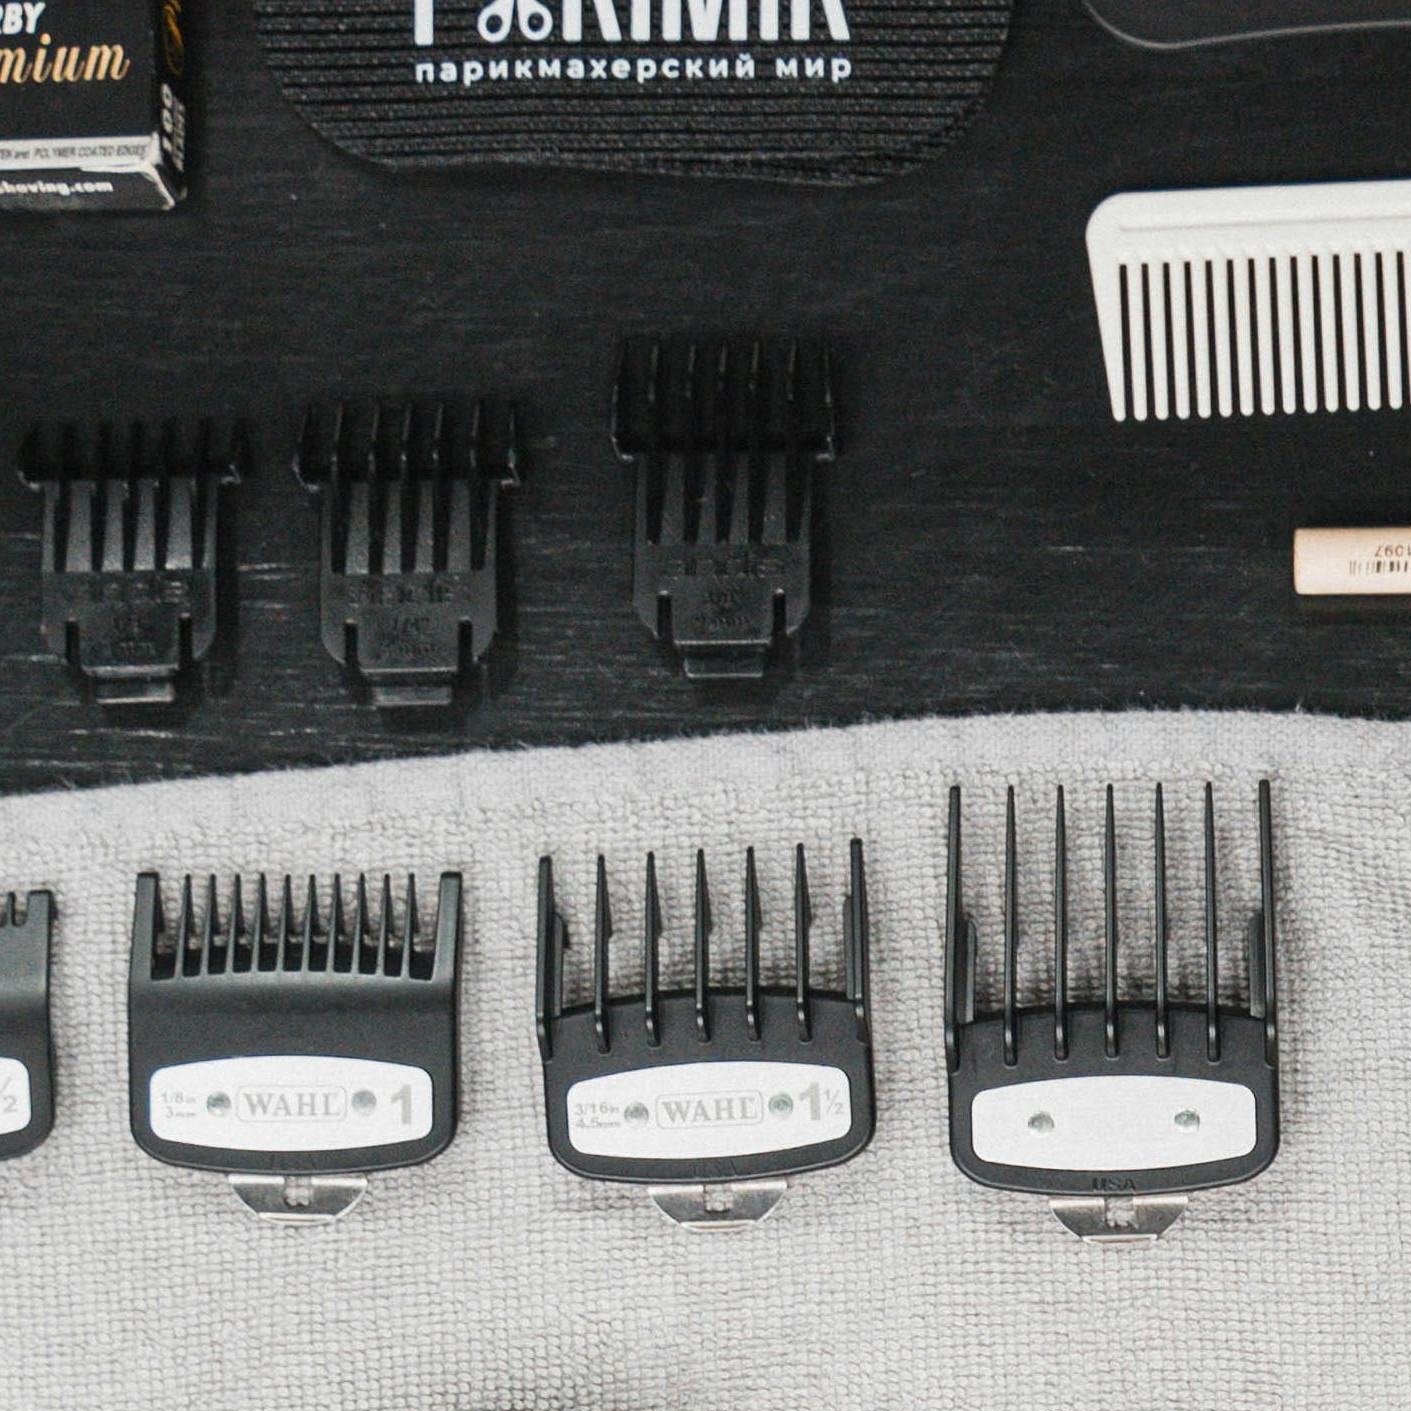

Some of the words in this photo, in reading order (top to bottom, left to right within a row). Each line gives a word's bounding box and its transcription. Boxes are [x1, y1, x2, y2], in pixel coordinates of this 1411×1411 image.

[0, 2, 46, 34] BY
[415, 53, 755, 86] парикмахерский
[776, 56, 852, 83] мир
[242, 1092, 341, 1117] WAHL
[391, 1084, 412, 1126] 1
[661, 1096, 759, 1124] WAHL
